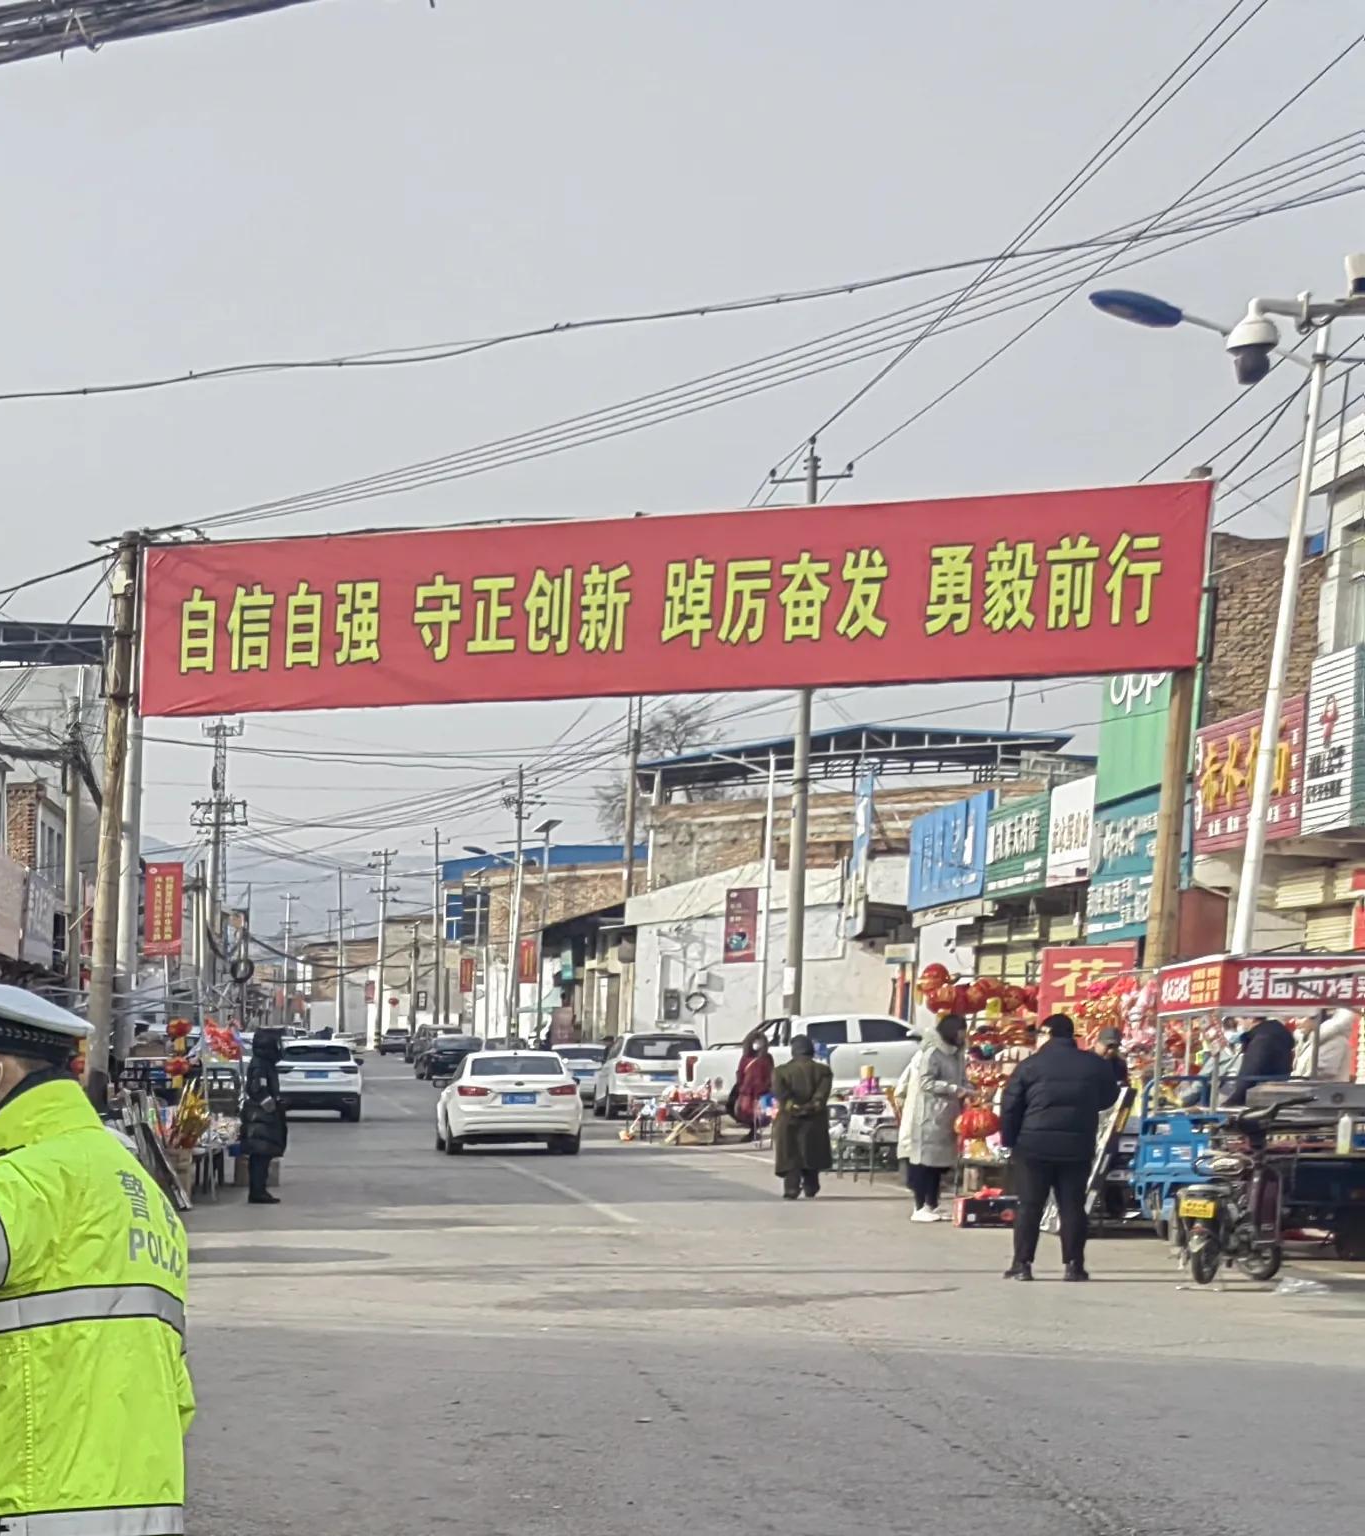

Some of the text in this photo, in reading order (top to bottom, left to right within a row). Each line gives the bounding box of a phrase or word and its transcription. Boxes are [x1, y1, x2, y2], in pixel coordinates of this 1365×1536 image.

[179, 532, 1163, 673] 自信自强 守正创新 踔厉奋发 勇毅前行
